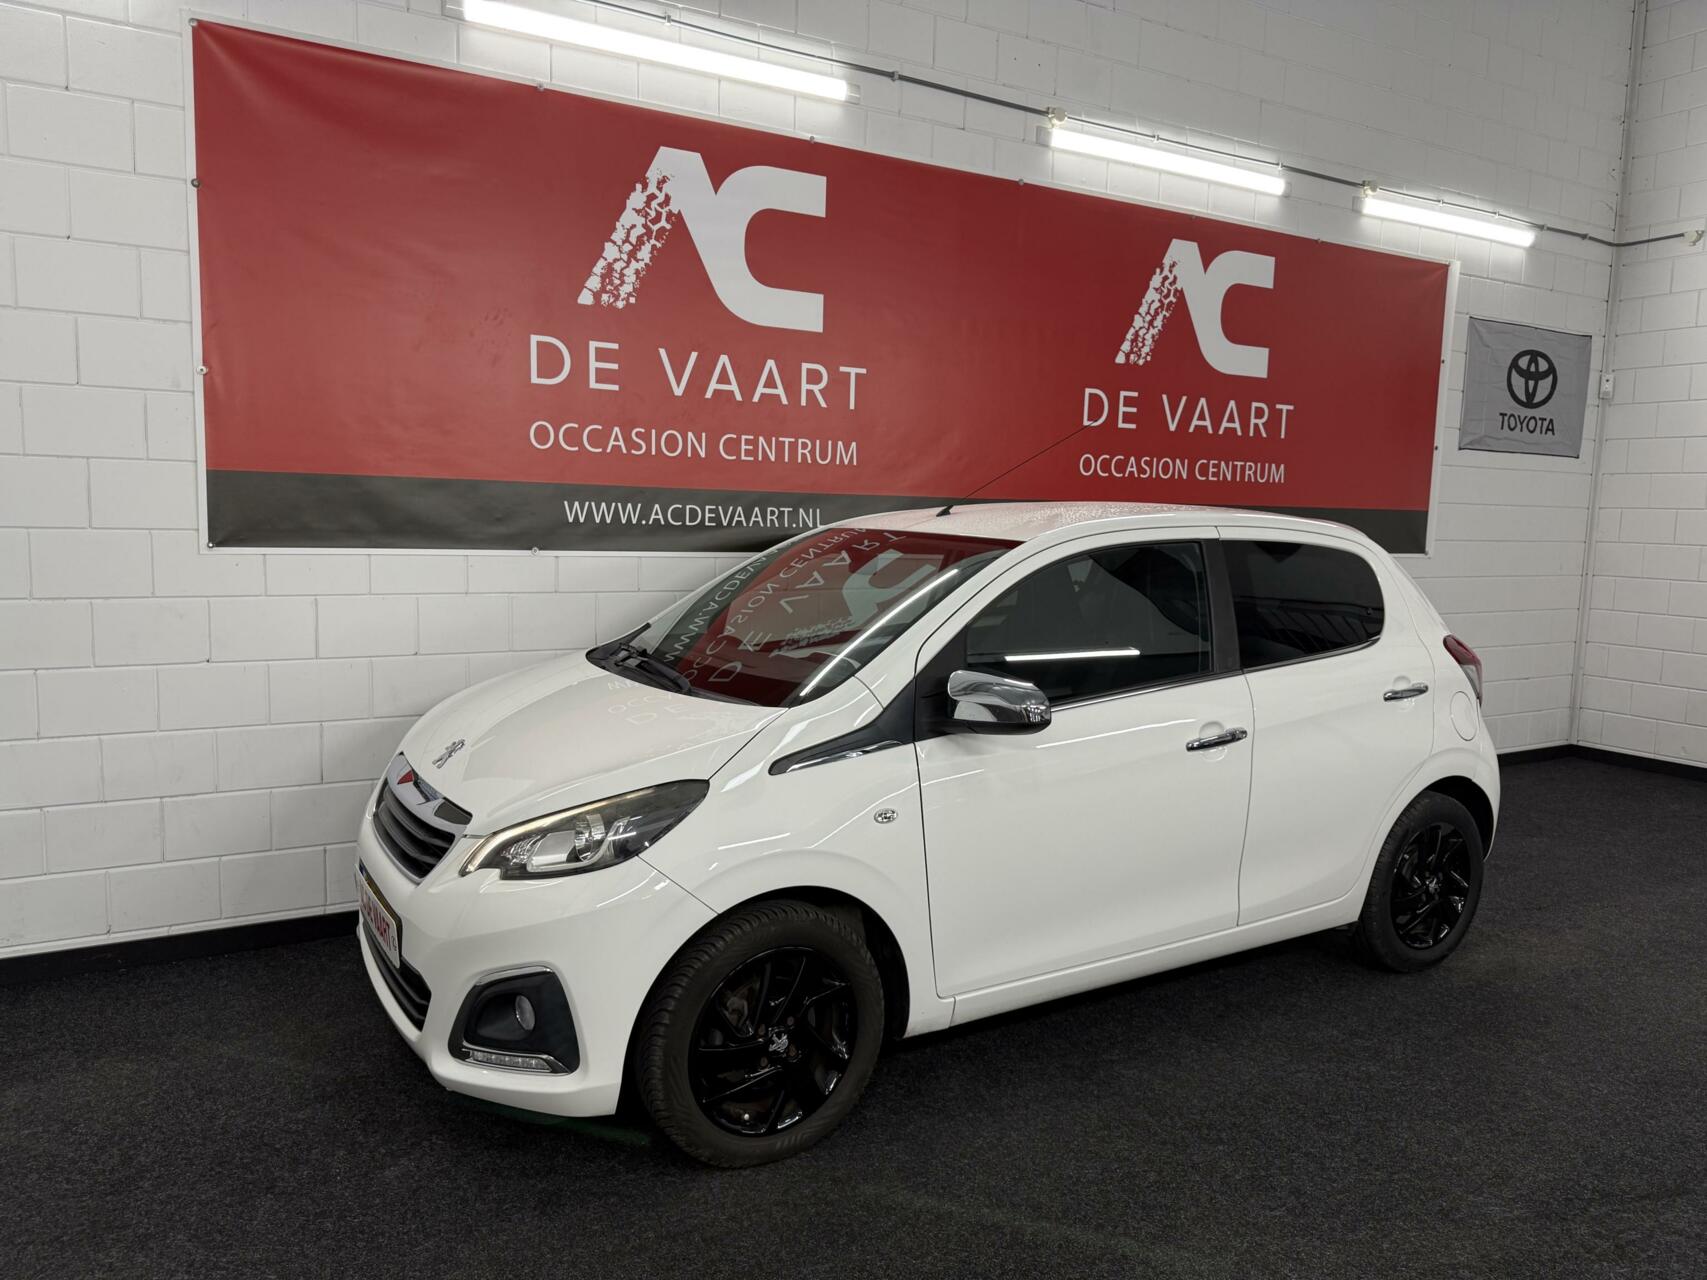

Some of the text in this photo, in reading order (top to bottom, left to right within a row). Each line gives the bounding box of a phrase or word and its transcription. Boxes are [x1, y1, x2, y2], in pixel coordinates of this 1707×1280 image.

[577, 146, 827, 332] AC
[1115, 239, 1275, 378] AC
[530, 334, 867, 410] DE VAART
[1083, 388, 1294, 439] DE VAART
[1499, 412, 1555, 436] TOYOTA
[529, 421, 857, 466] OCCASION CENTRUM
[1079, 454, 1285, 483] OCCASION CENTRUM
[564, 501, 823, 529] WWW.ACDEVAART.NL
